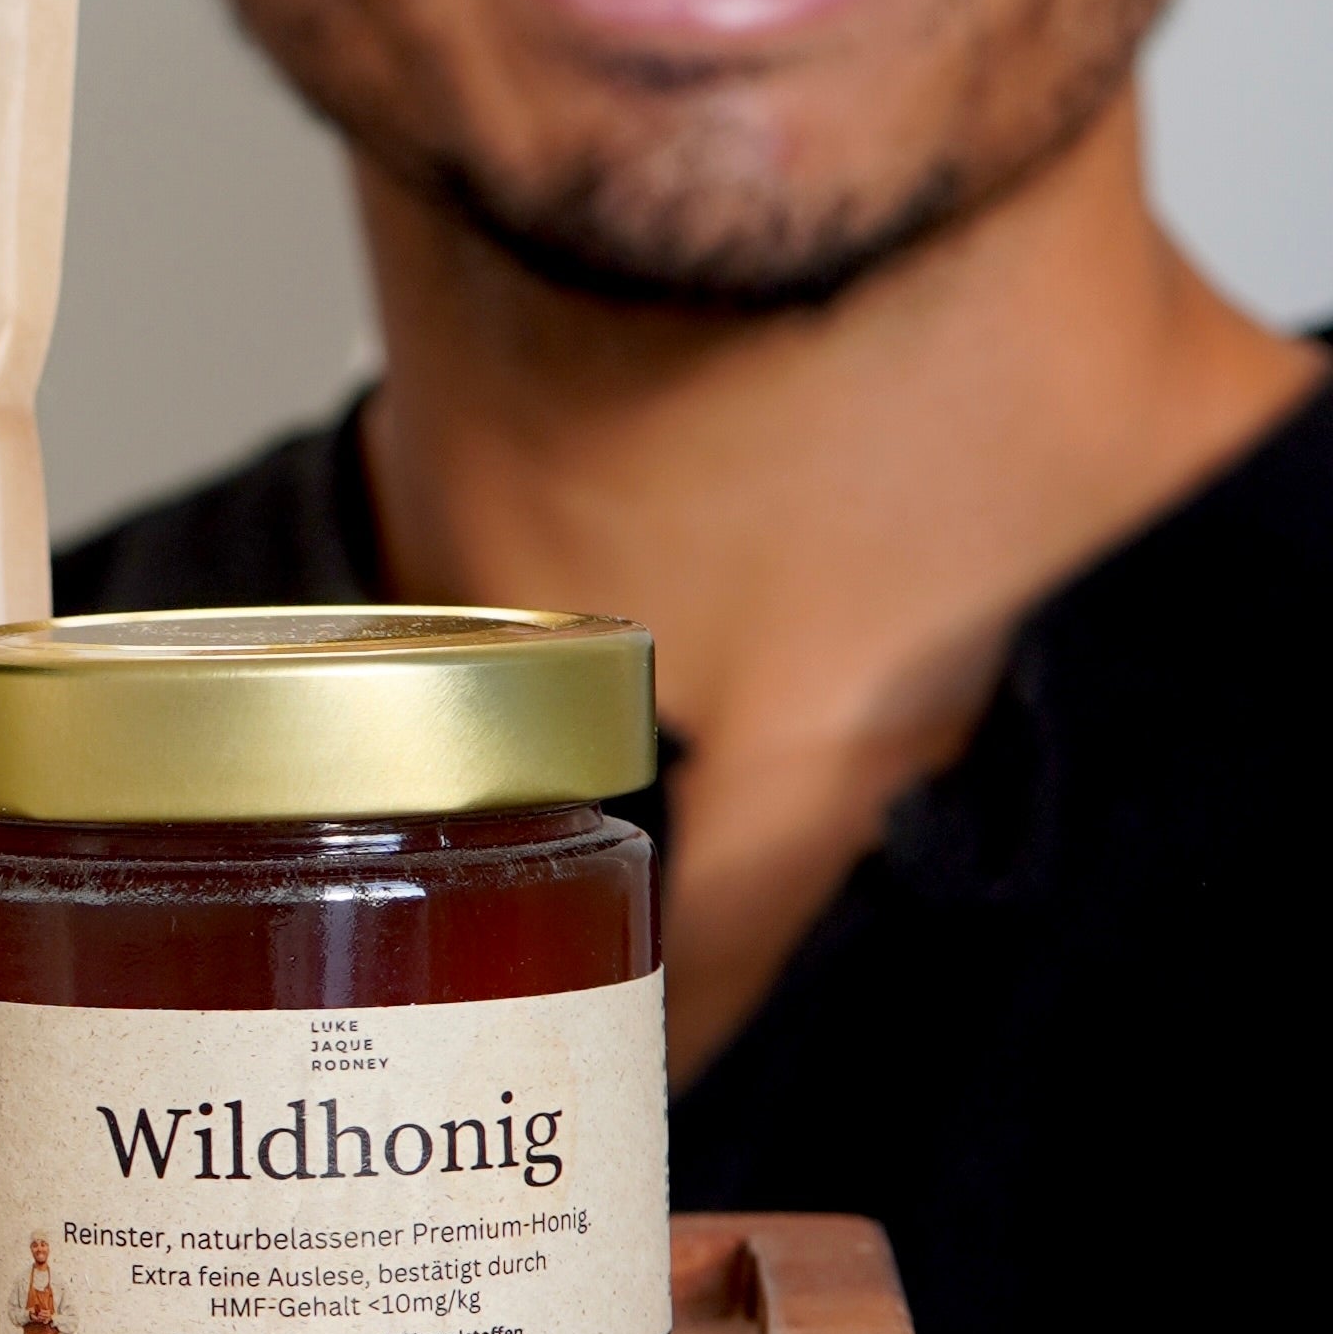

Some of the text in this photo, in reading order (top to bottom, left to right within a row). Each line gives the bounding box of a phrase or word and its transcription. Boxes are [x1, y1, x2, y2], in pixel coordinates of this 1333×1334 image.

[311, 1020, 359, 1033] LUKE
[311, 1039, 373, 1053] JAQUE
[311, 1058, 389, 1071] RODNEY
[96, 1090, 563, 1187] Wildhonig
[64, 1207, 592, 1254] Reinster, naturbelassener Premium-Honig.
[132, 1251, 547, 1289] Extra feine Auslese, bestätigt durch
[211, 1289, 481, 1318] HMF-Gehalt <10mg/kg
